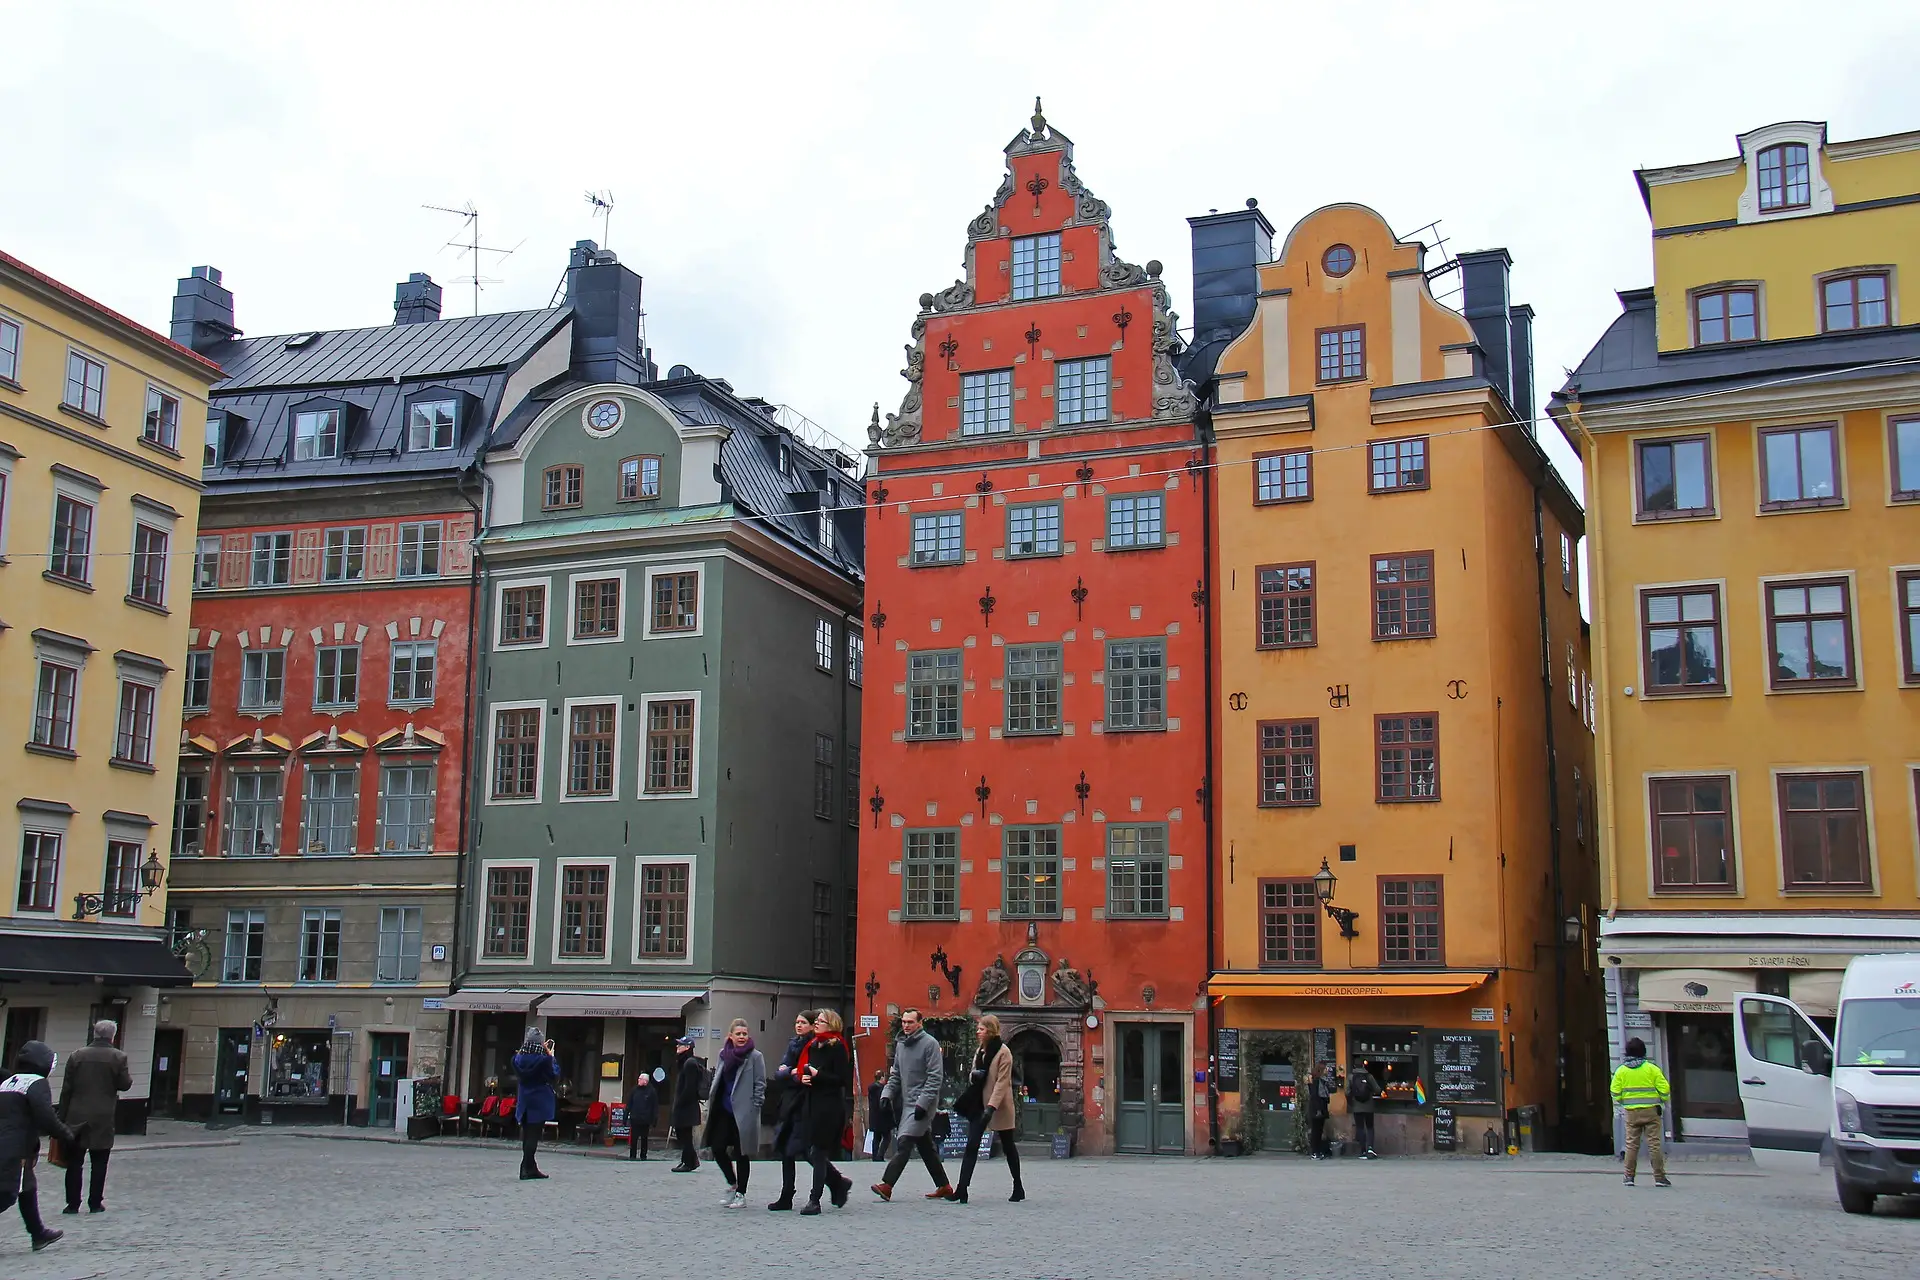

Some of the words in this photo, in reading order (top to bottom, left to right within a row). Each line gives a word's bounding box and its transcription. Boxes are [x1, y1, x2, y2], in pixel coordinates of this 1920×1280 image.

[1748, 957, 1758, 966] DE
[1760, 957, 1785, 966] SVARTA
[1786, 955, 1810, 967] FÅREN
